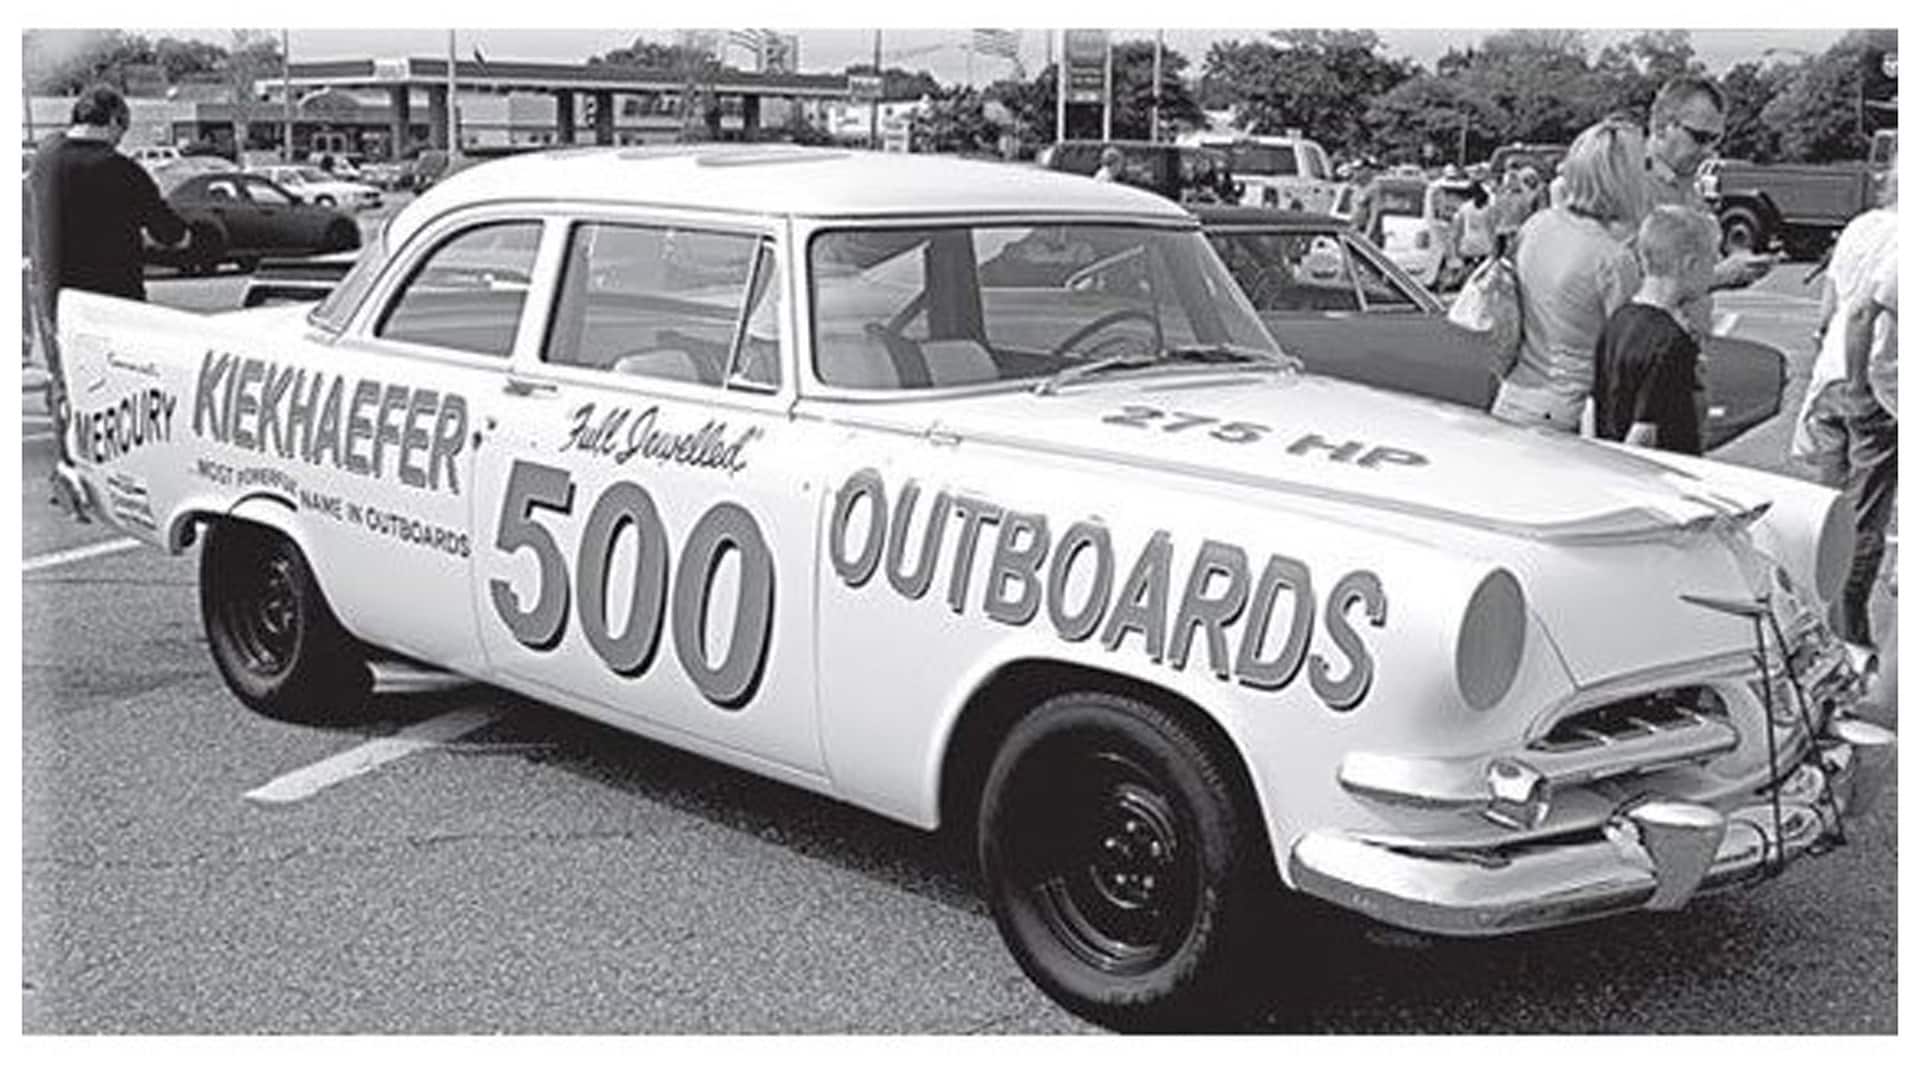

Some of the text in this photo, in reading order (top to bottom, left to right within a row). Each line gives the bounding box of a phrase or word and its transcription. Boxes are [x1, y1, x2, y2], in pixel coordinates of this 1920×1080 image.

[74, 388, 177, 464] MERCURY
[192, 349, 468, 495] KIEKHAEFER
[1101, 405, 1430, 469] 275 HP
[198, 458, 233, 486] MOST
[300, 489, 342, 521] NAME
[348, 502, 363, 525] IN
[366, 506, 471, 558] OUTBOARDS
[489, 458, 776, 711] 500
[829, 466, 1388, 712] OUTBOARDS
